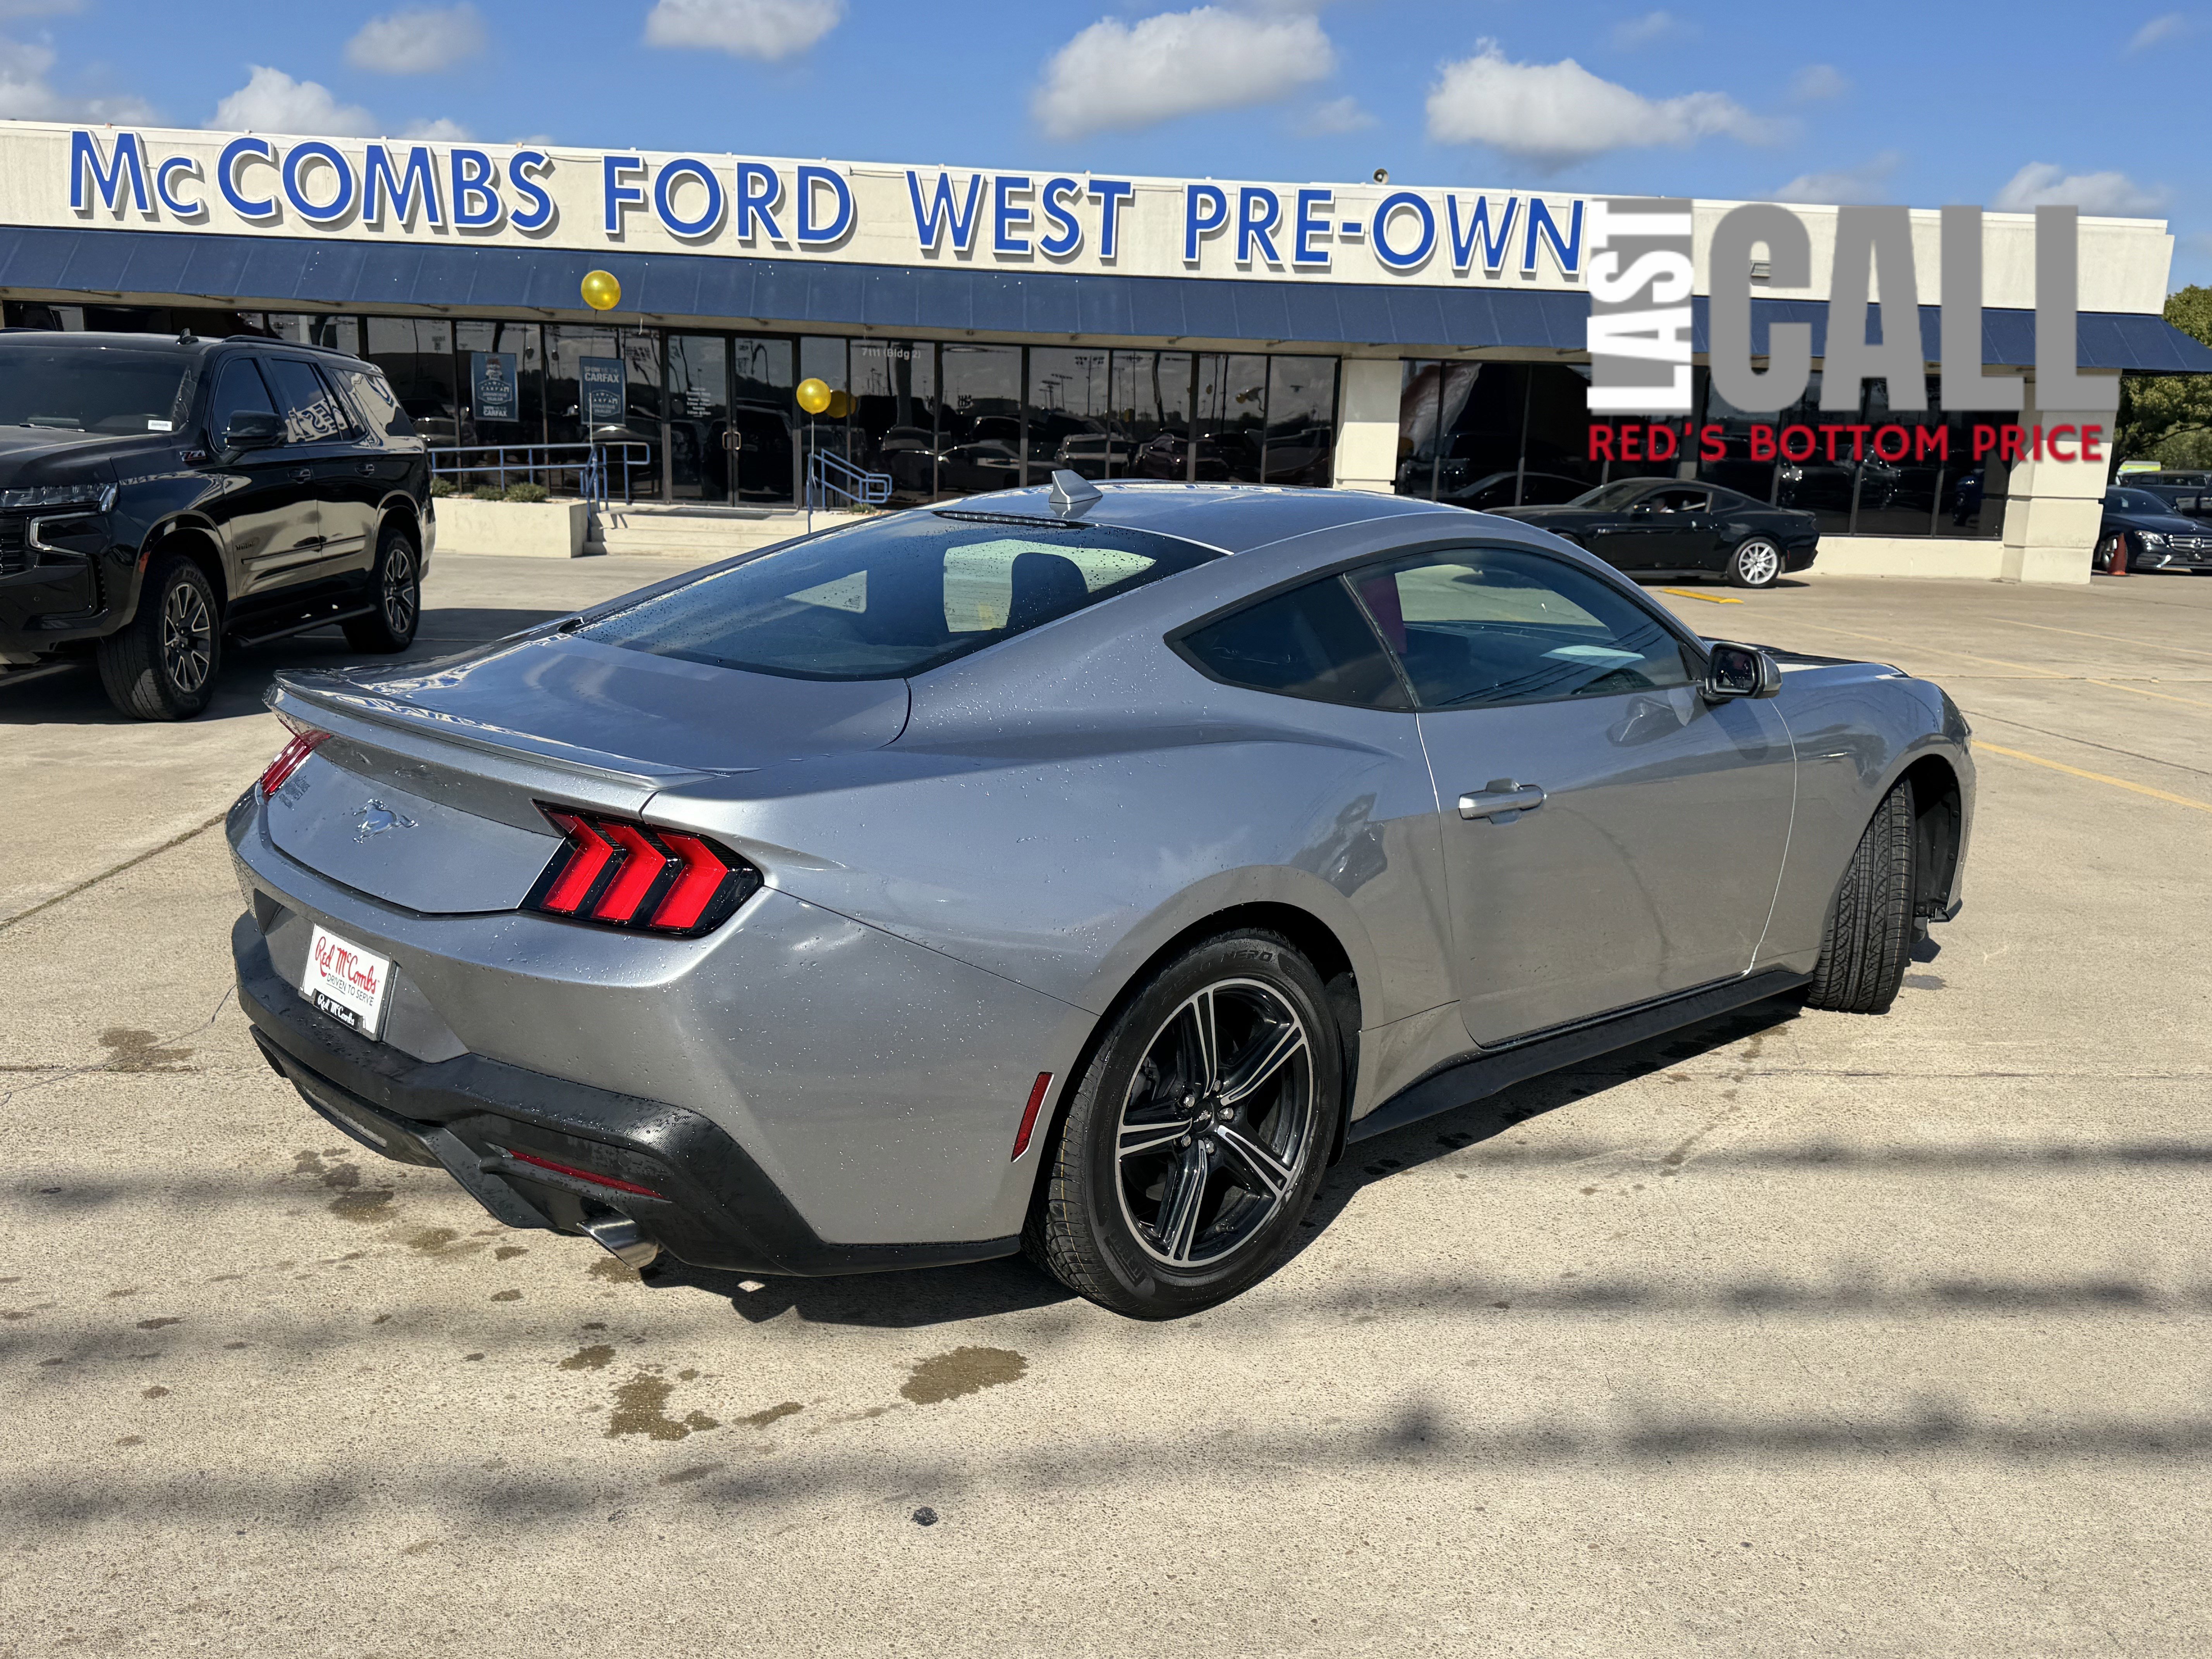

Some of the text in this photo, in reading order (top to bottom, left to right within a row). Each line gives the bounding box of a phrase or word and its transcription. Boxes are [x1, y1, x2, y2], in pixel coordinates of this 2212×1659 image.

[602, 155, 854, 249] FORD
[905, 169, 1133, 258] WEST
[862, 347, 921, 361] 7111 (Bldg 2)
[584, 372, 619, 383] CARFAX
[315, 936, 335, 977] Red
[327, 973, 374, 1007] DRIVEN TO SERVE
